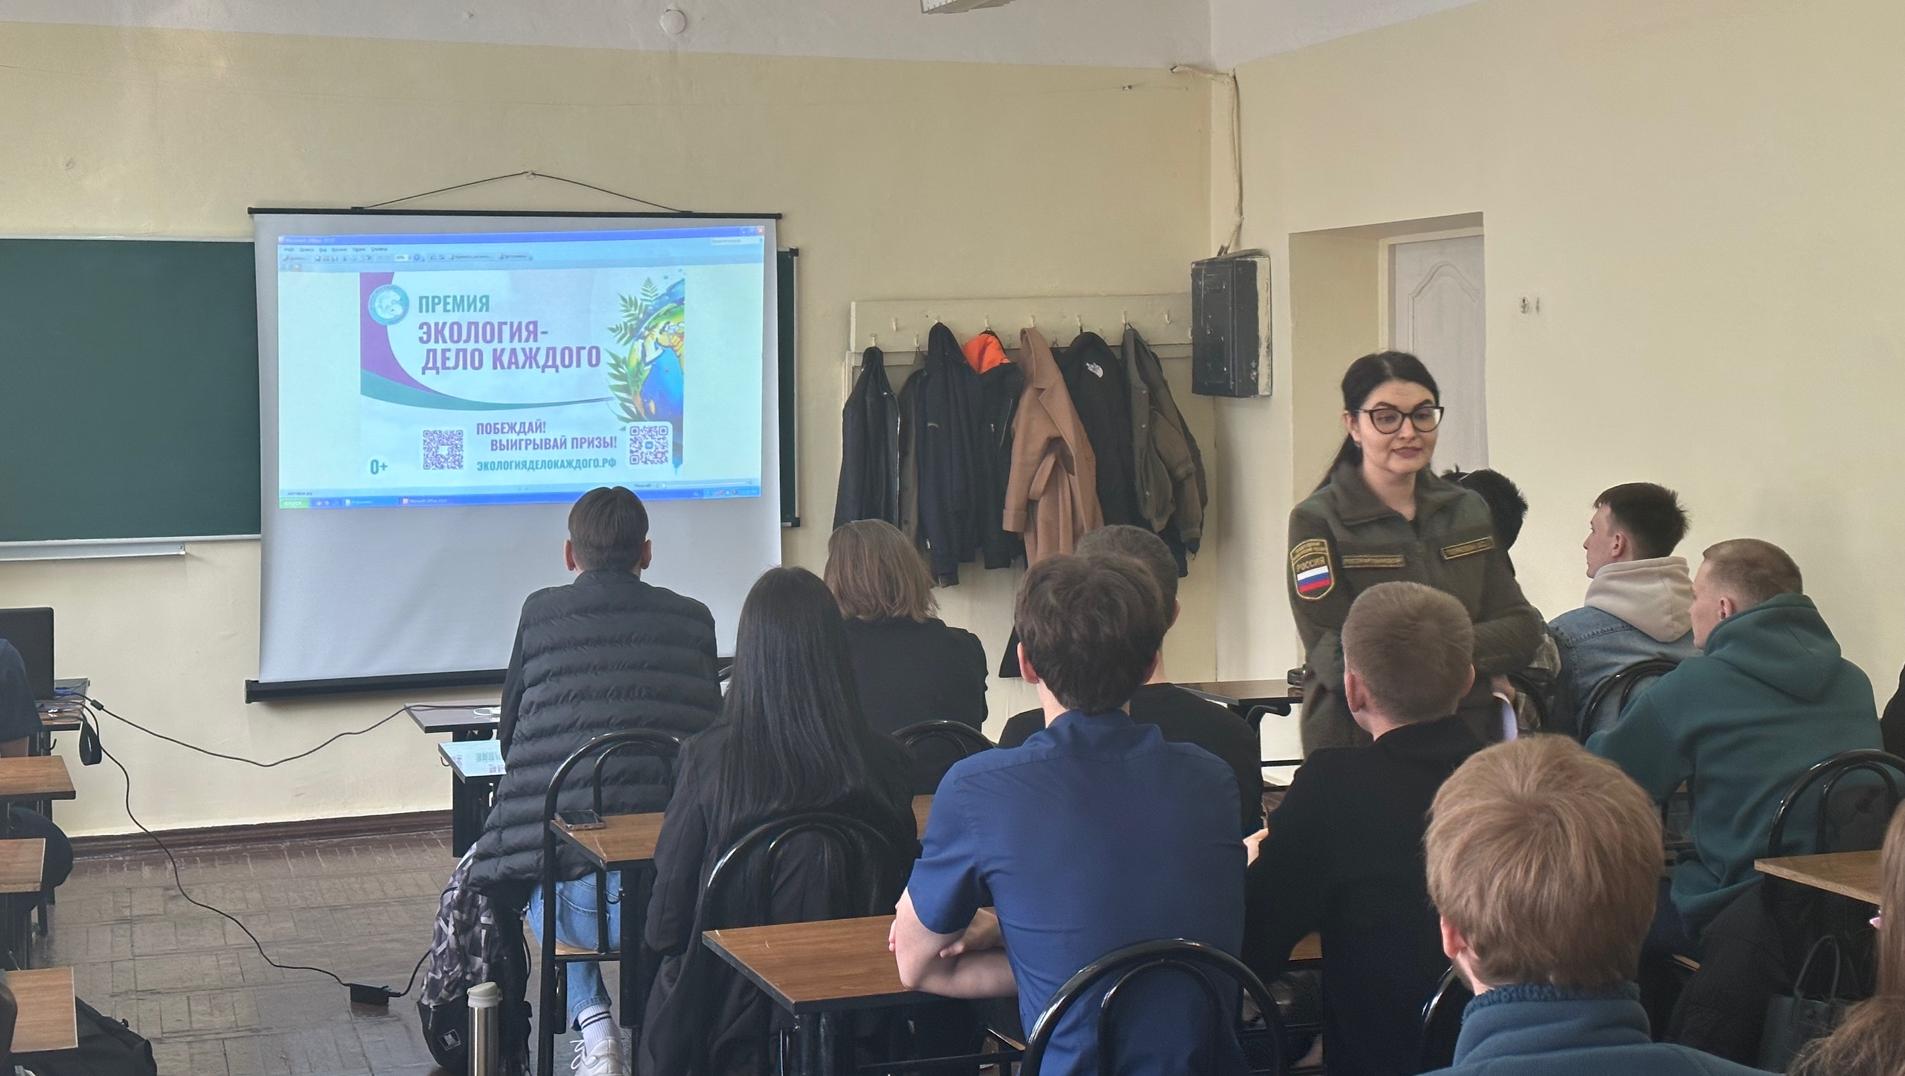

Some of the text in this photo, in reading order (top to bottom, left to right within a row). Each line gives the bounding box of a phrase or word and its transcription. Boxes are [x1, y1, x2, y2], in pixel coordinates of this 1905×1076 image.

[418, 294, 490, 314] ПРЕМИЯ
[418, 320, 549, 345] ЭКОЛОГИЯ-
[421, 345, 601, 375] ДЕЛО КАЖДОГО
[476, 418, 547, 436] ПОБЕЖДАЙ!
[490, 435, 618, 452] ВЫИГРЫВАЙ ПРИЗЫ!
[370, 458, 388, 475] 0+
[477, 458, 617, 472] ЭКОЛОГИЯДЕЛОКАЖДОГО.РФ
[1296, 557, 1325, 572] РОССИЯ
